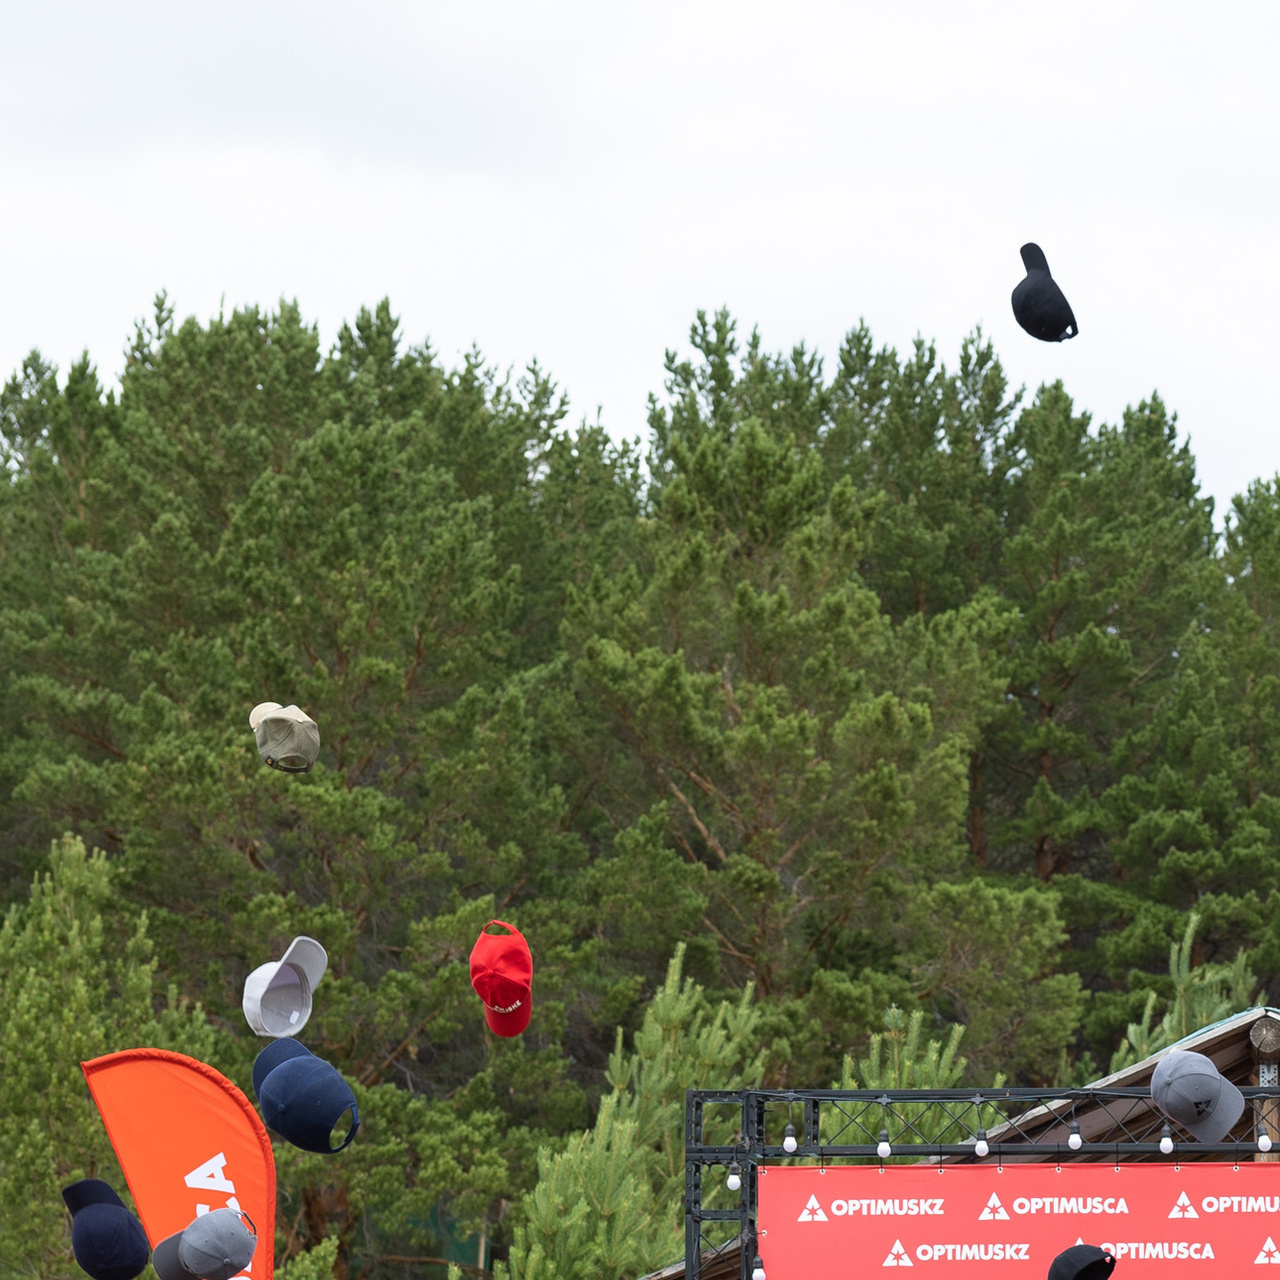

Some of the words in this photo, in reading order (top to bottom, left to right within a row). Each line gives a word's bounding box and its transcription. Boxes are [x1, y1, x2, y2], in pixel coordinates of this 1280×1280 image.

[830, 1198, 945, 1217] OPTIMUSKZ
[1012, 1196, 1129, 1215] OPTIMUSCA
[915, 1243, 1030, 1261] OPTIMUSKZ
[1099, 1241, 1216, 1260] OPTIMUSCA
